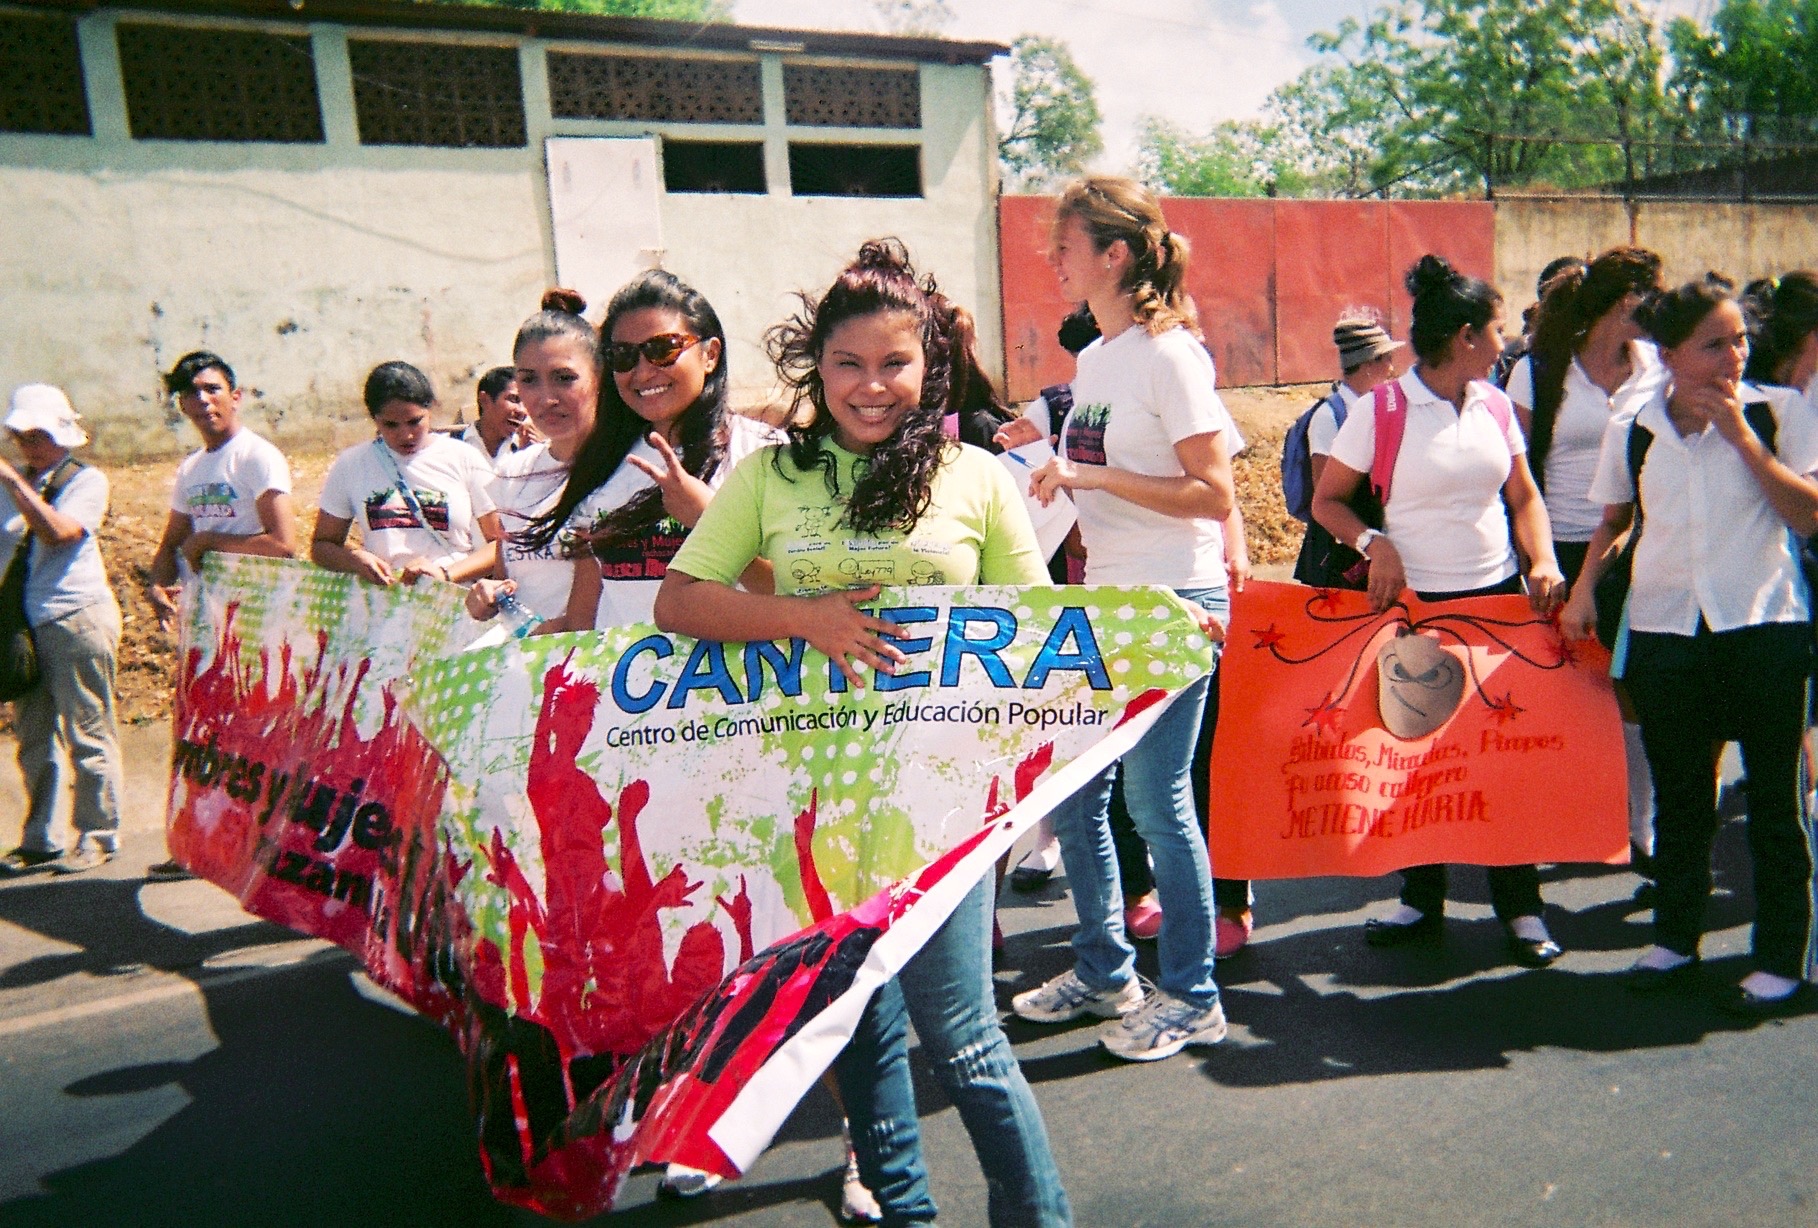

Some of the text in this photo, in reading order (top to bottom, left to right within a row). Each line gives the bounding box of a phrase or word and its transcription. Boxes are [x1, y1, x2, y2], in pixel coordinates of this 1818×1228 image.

[607, 701, 1109, 747] Centro de Comunicación y Educación Popular
